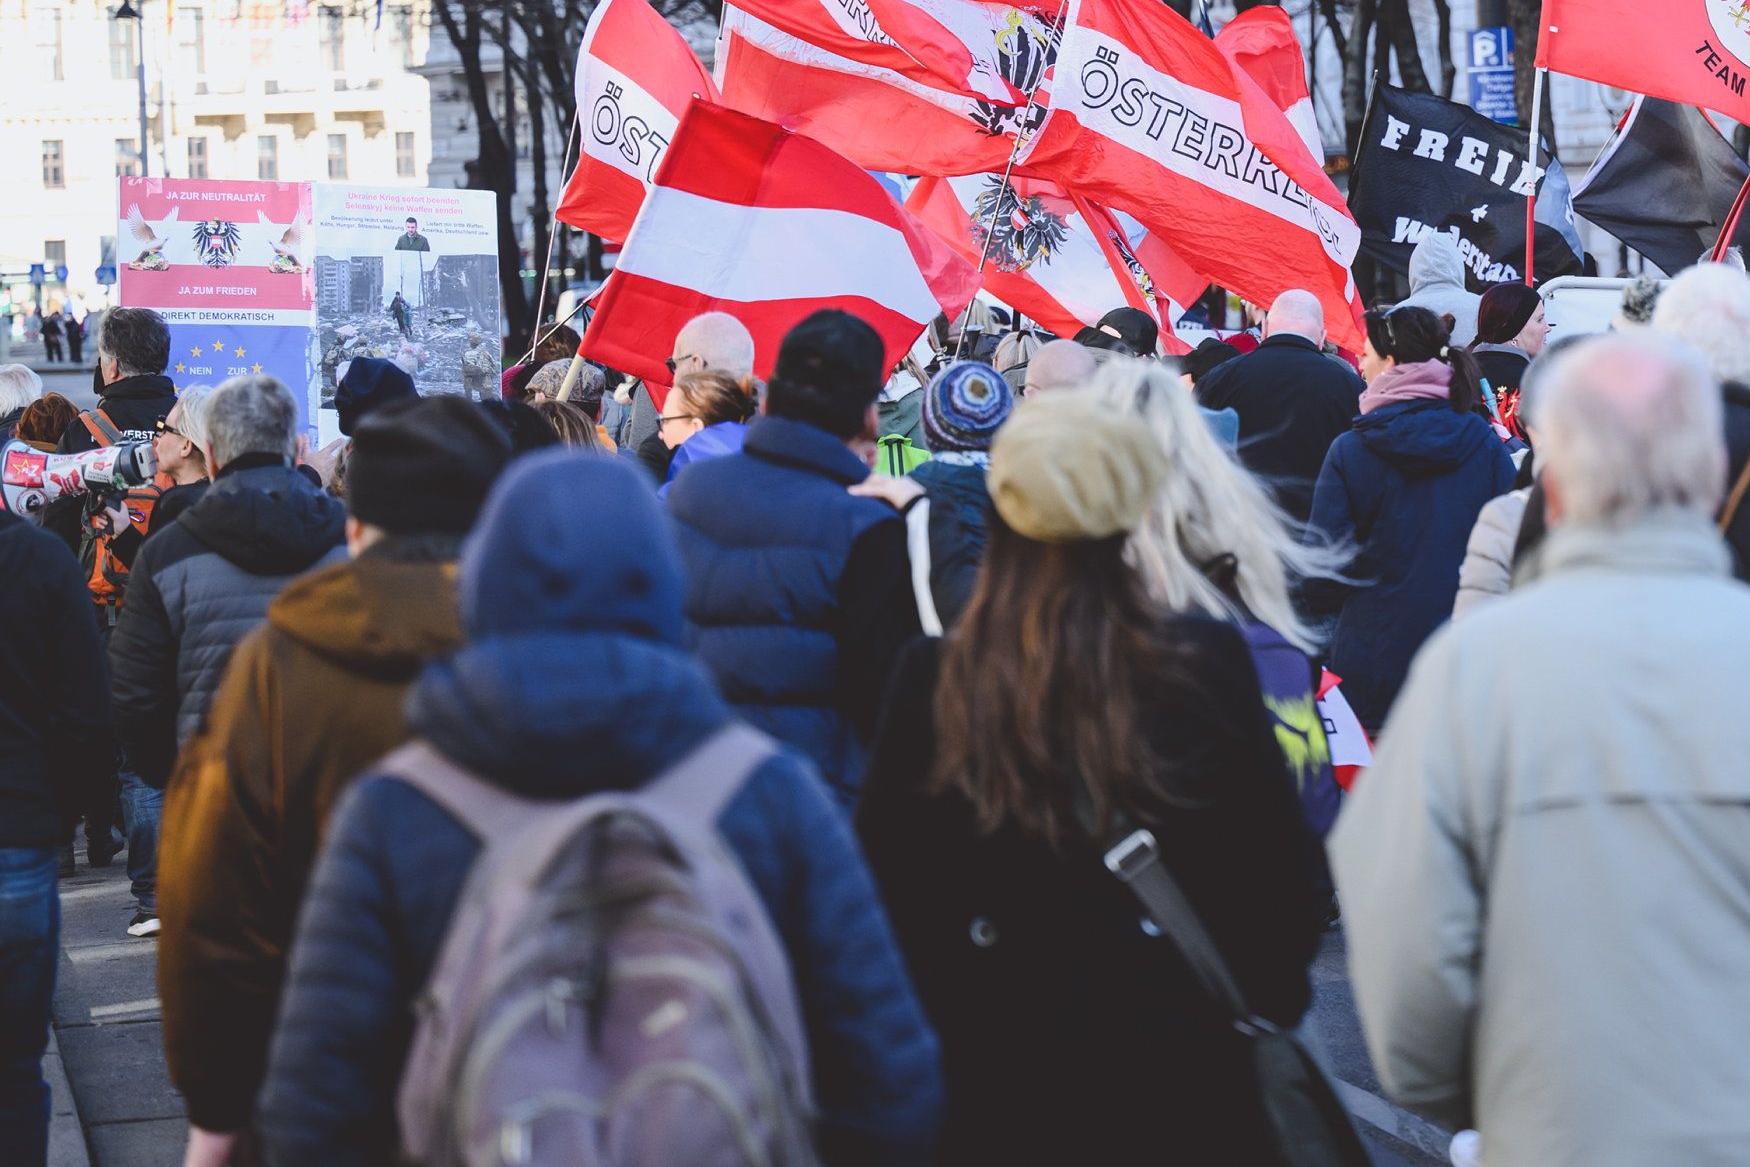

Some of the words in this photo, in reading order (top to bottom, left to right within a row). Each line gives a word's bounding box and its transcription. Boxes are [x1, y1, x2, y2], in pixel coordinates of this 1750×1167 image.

[1696, 40, 1746, 97] TEAM
[166, 192, 180, 200] JA
[180, 192, 199, 201] ZUR
[201, 192, 266, 202] NEUTRALITÄT
[348, 192, 378, 201] Ukraine
[380, 193, 400, 203] Krieg
[402, 194, 425, 203] sofort
[426, 196, 460, 204] beenden
[384, 203, 405, 211] keine
[407, 205, 433, 213] Waffen
[435, 207, 463, 215] senden
[178, 286, 191, 295] JA
[193, 286, 214, 295] ZUM
[216, 287, 257, 296] FRIEDEN
[161, 312, 197, 320] DIREKT
[199, 312, 275, 321] DEMOKRATISCH
[189, 367, 213, 375] NEIN
[227, 367, 248, 375] ZUR
